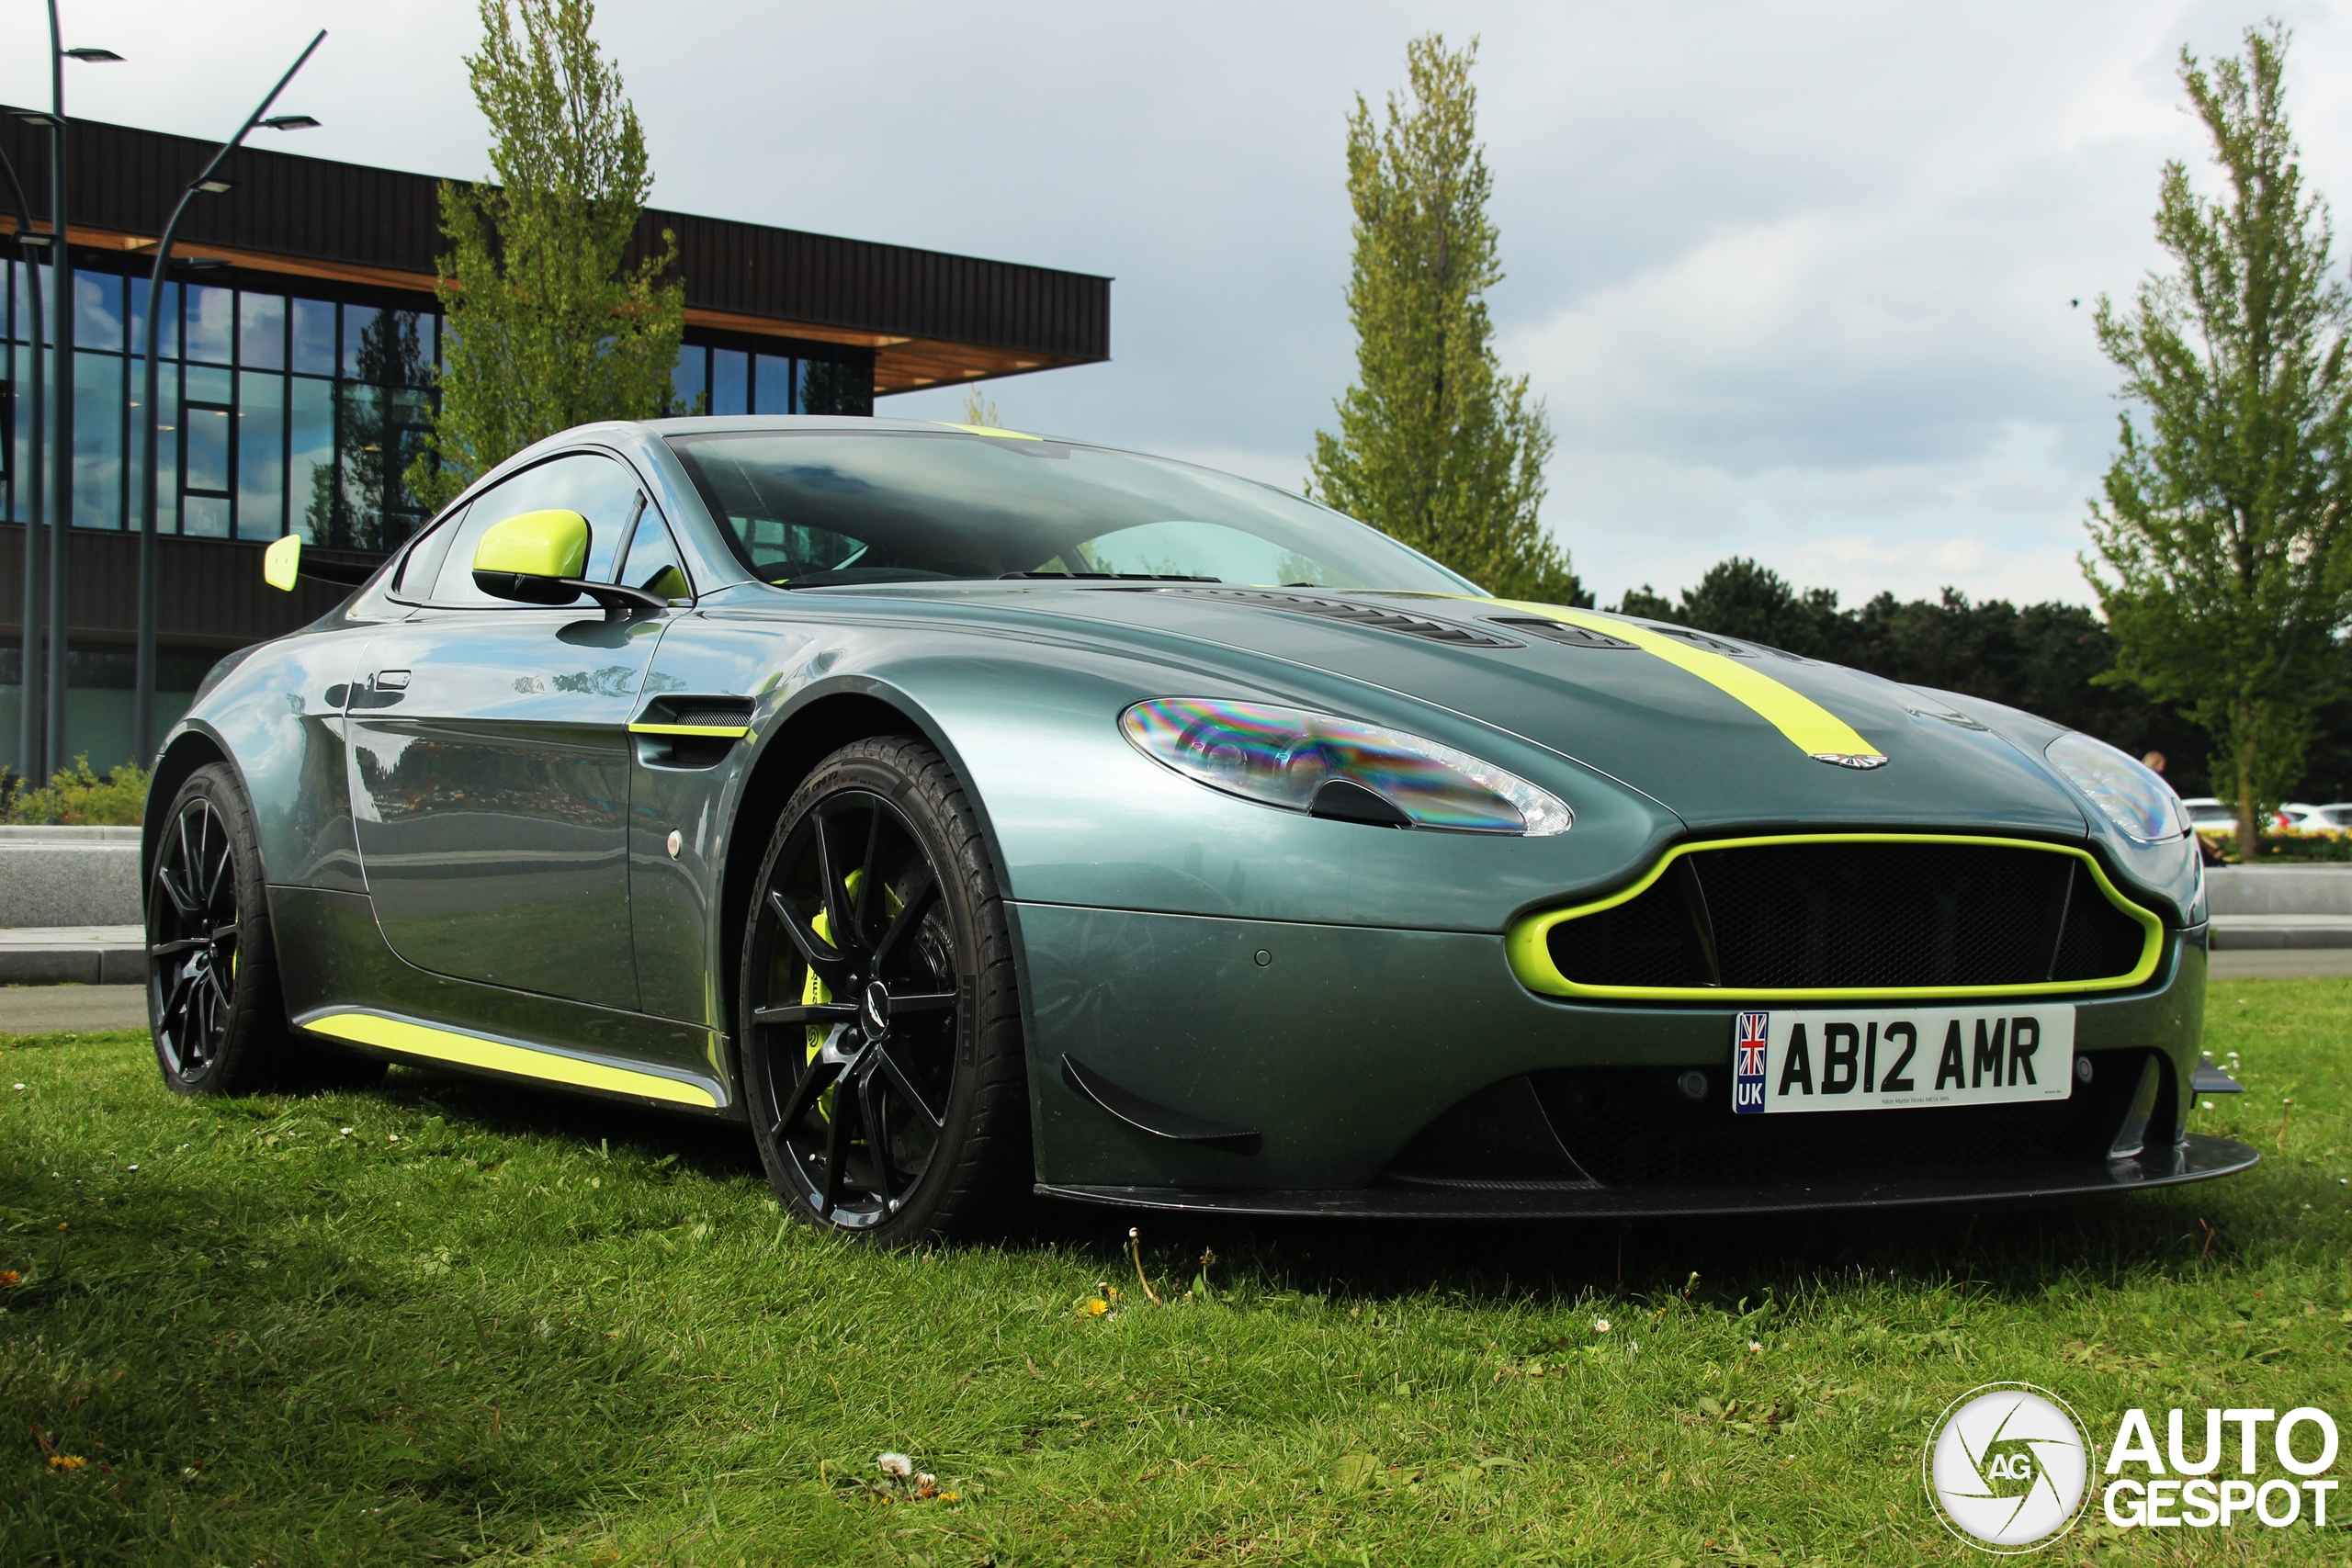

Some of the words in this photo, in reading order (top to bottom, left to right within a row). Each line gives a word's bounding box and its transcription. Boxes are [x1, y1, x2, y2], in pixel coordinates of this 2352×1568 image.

[961, 975, 976, 1067] PIRELLI
[1778, 1021, 1917, 1096] AB12
[1934, 1016, 2041, 1090] AMR
[1738, 1082, 1762, 1105] UK
